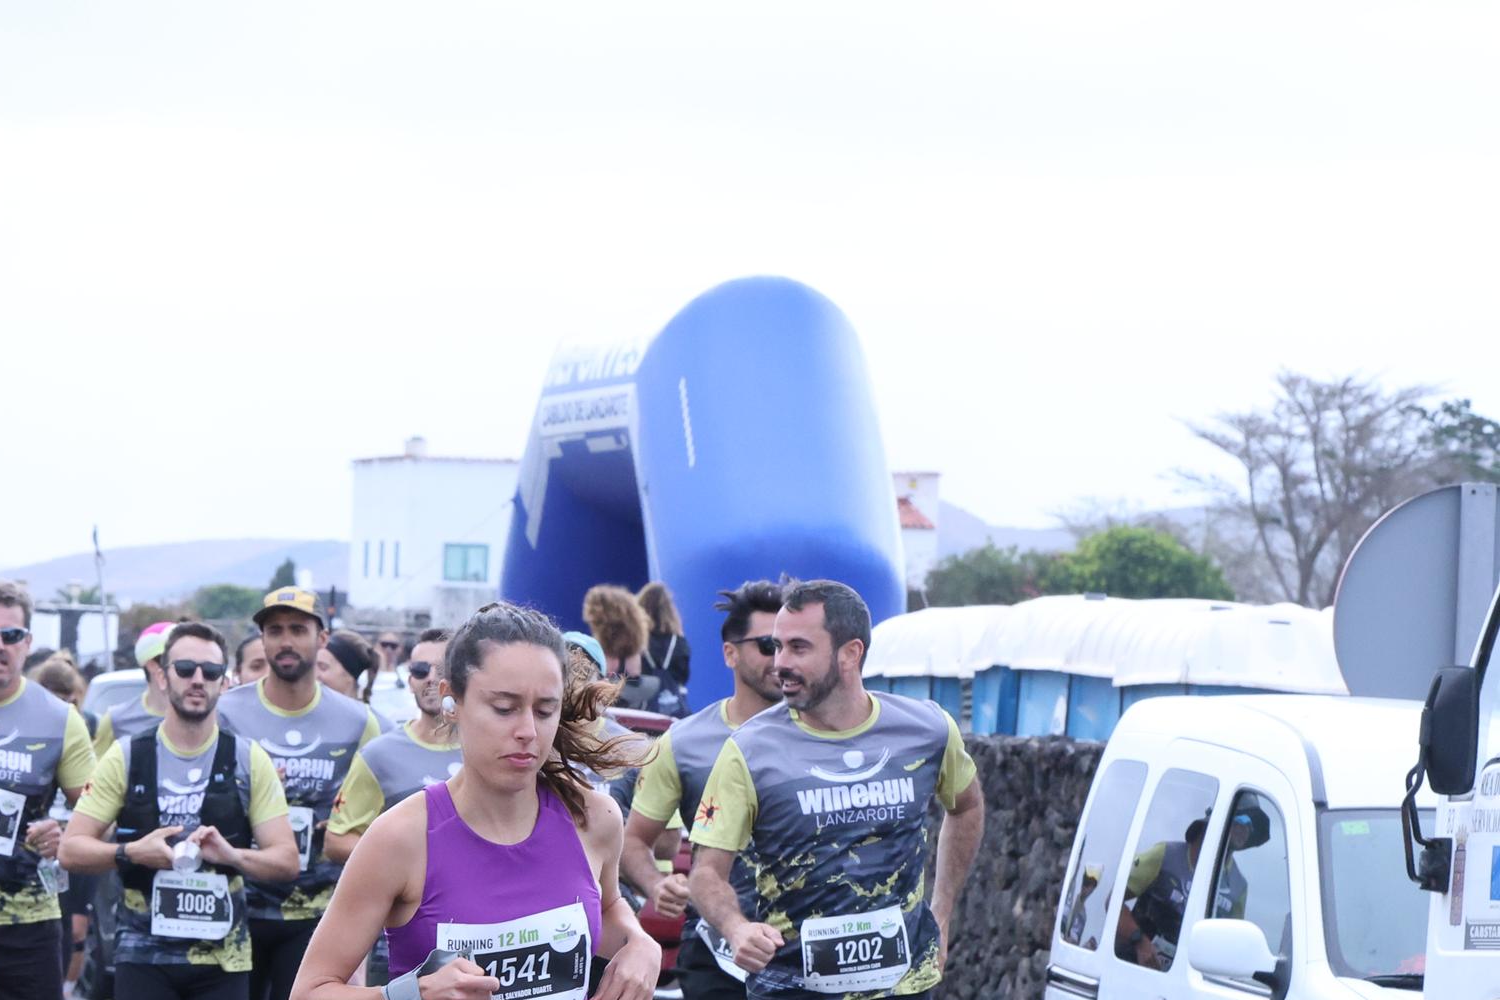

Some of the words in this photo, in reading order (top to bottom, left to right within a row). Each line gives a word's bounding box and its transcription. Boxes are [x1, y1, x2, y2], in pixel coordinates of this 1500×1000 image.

[816, 805, 905, 829] LANZAROTE
[176, 892, 216, 914] 1008
[448, 938, 493, 950] RUNNING
[498, 931, 515, 947] 12
[519, 928, 539, 944] Km
[808, 926, 839, 937] RUNNING
[842, 922, 854, 934] 12
[857, 920, 872, 932] Km
[835, 937, 884, 965] 1202
[485, 951, 551, 987] 1541
[505, 988, 532, 1000] SALVADOR
[532, 984, 553, 995] DUARTE
